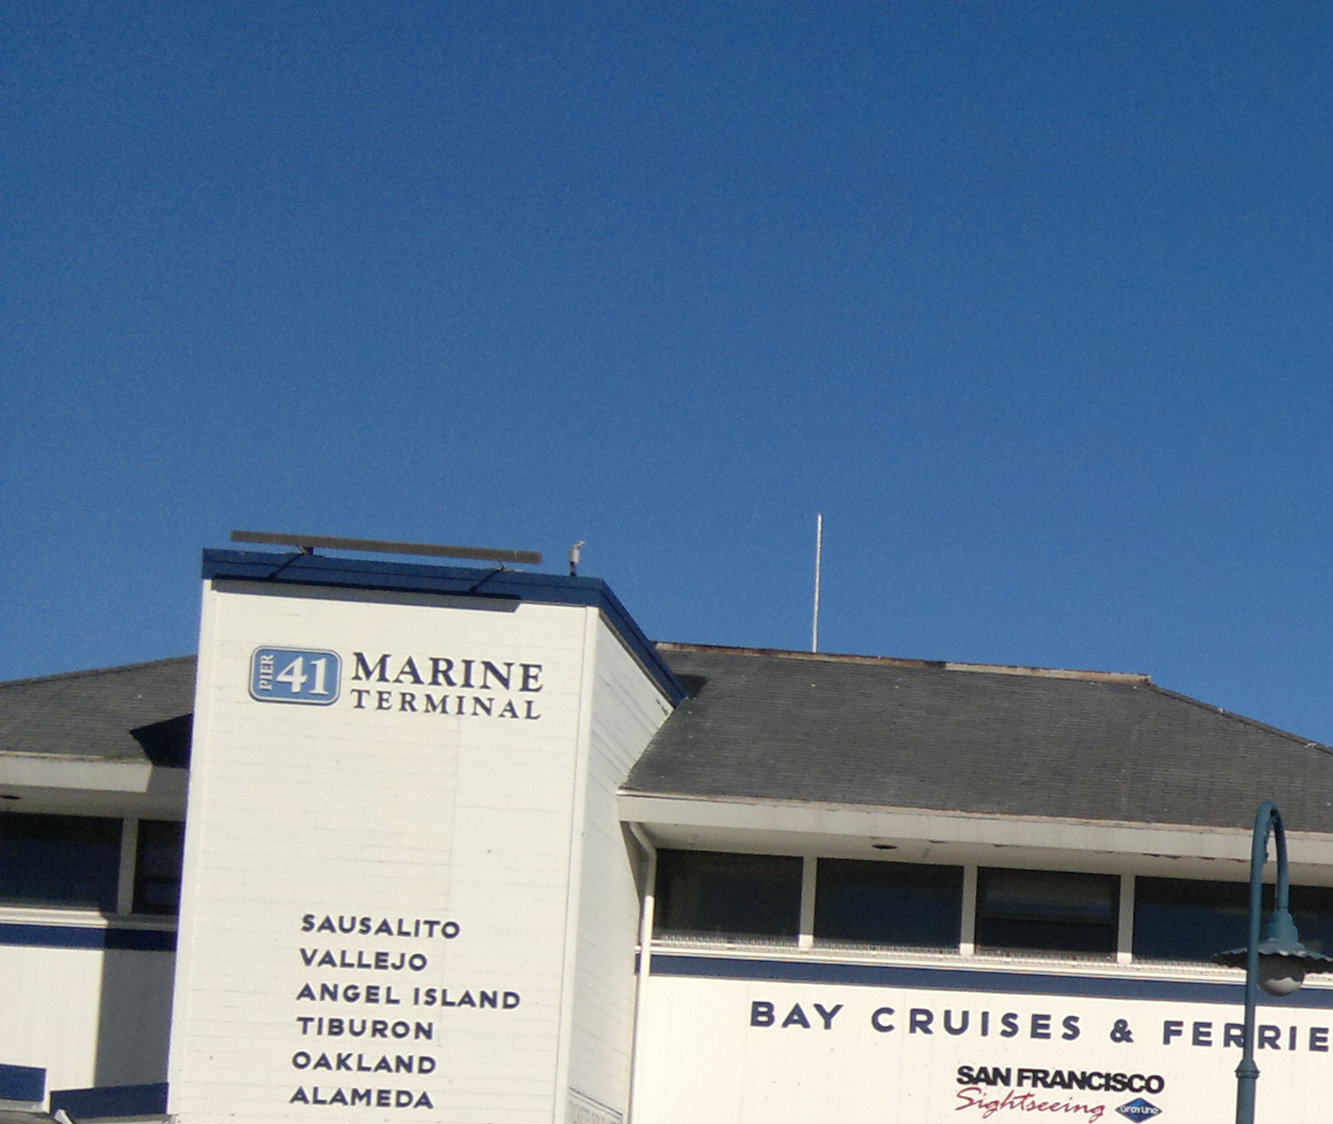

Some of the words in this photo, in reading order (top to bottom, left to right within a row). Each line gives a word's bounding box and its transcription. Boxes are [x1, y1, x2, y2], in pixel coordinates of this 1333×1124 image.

[259, 654, 274, 690] PIER
[276, 656, 329, 695] 41
[352, 652, 544, 692] MARINE
[351, 689, 541, 720] TERMINAL
[301, 914, 461, 939] SAUSALITO
[299, 948, 427, 971] VALLEJO
[296, 983, 400, 1005] ANGEL
[413, 987, 521, 1010] ISLAND
[296, 1017, 434, 1040] TIBURON
[749, 1001, 844, 1030] BAY
[871, 1006, 1081, 1041] CRUISES
[1110, 1019, 1134, 1043] &
[292, 1051, 437, 1075] OAKLAND
[956, 1065, 1011, 1089] SAN
[1017, 1067, 1165, 1094] FRANCISCO
[289, 1087, 434, 1109] ALAMEDA
[955, 1087, 1105, 1124] Sightseeing
